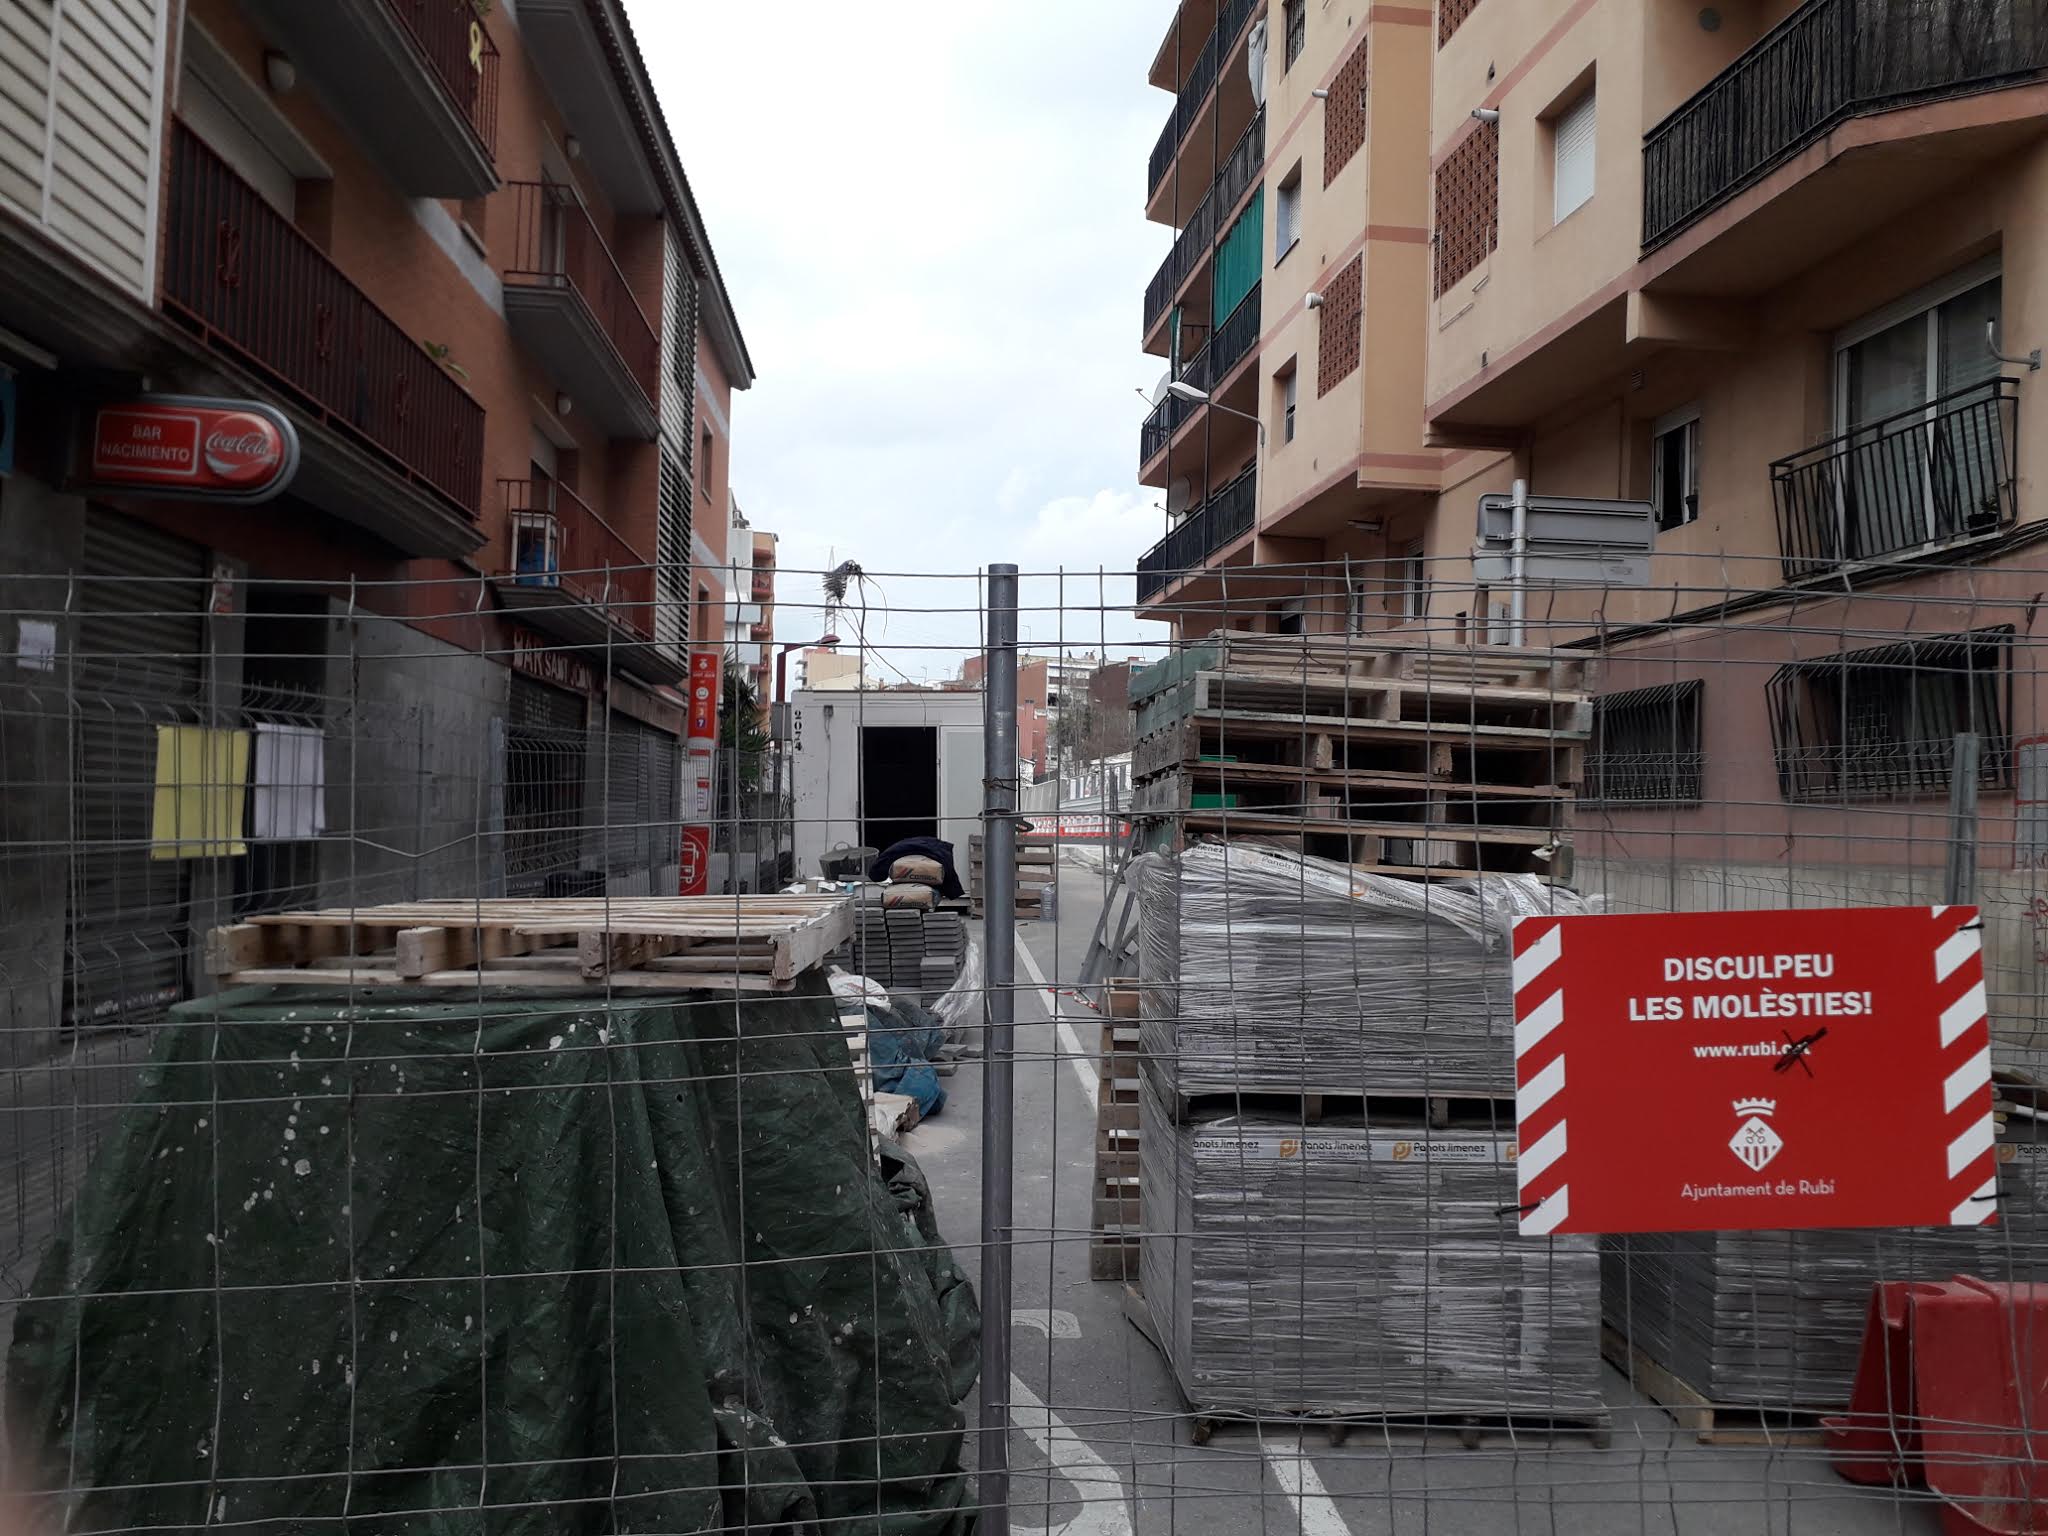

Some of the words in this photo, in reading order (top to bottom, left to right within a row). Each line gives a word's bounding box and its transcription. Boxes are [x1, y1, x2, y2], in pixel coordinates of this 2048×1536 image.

[133, 424, 161, 440] BAR
[101, 442, 190, 463] NACIMIENTO
[1664, 953, 1833, 982] DISCULPEU
[1628, 996, 1684, 1022] LES
[1692, 986, 1873, 1020] MOLÈSTIES!
[1413, 1142, 1446, 1152] Panots
[1447, 1142, 1486, 1153] Jimenez
[1680, 1182, 1772, 1201] Ajuntament
[1775, 1179, 1796, 1196] de
